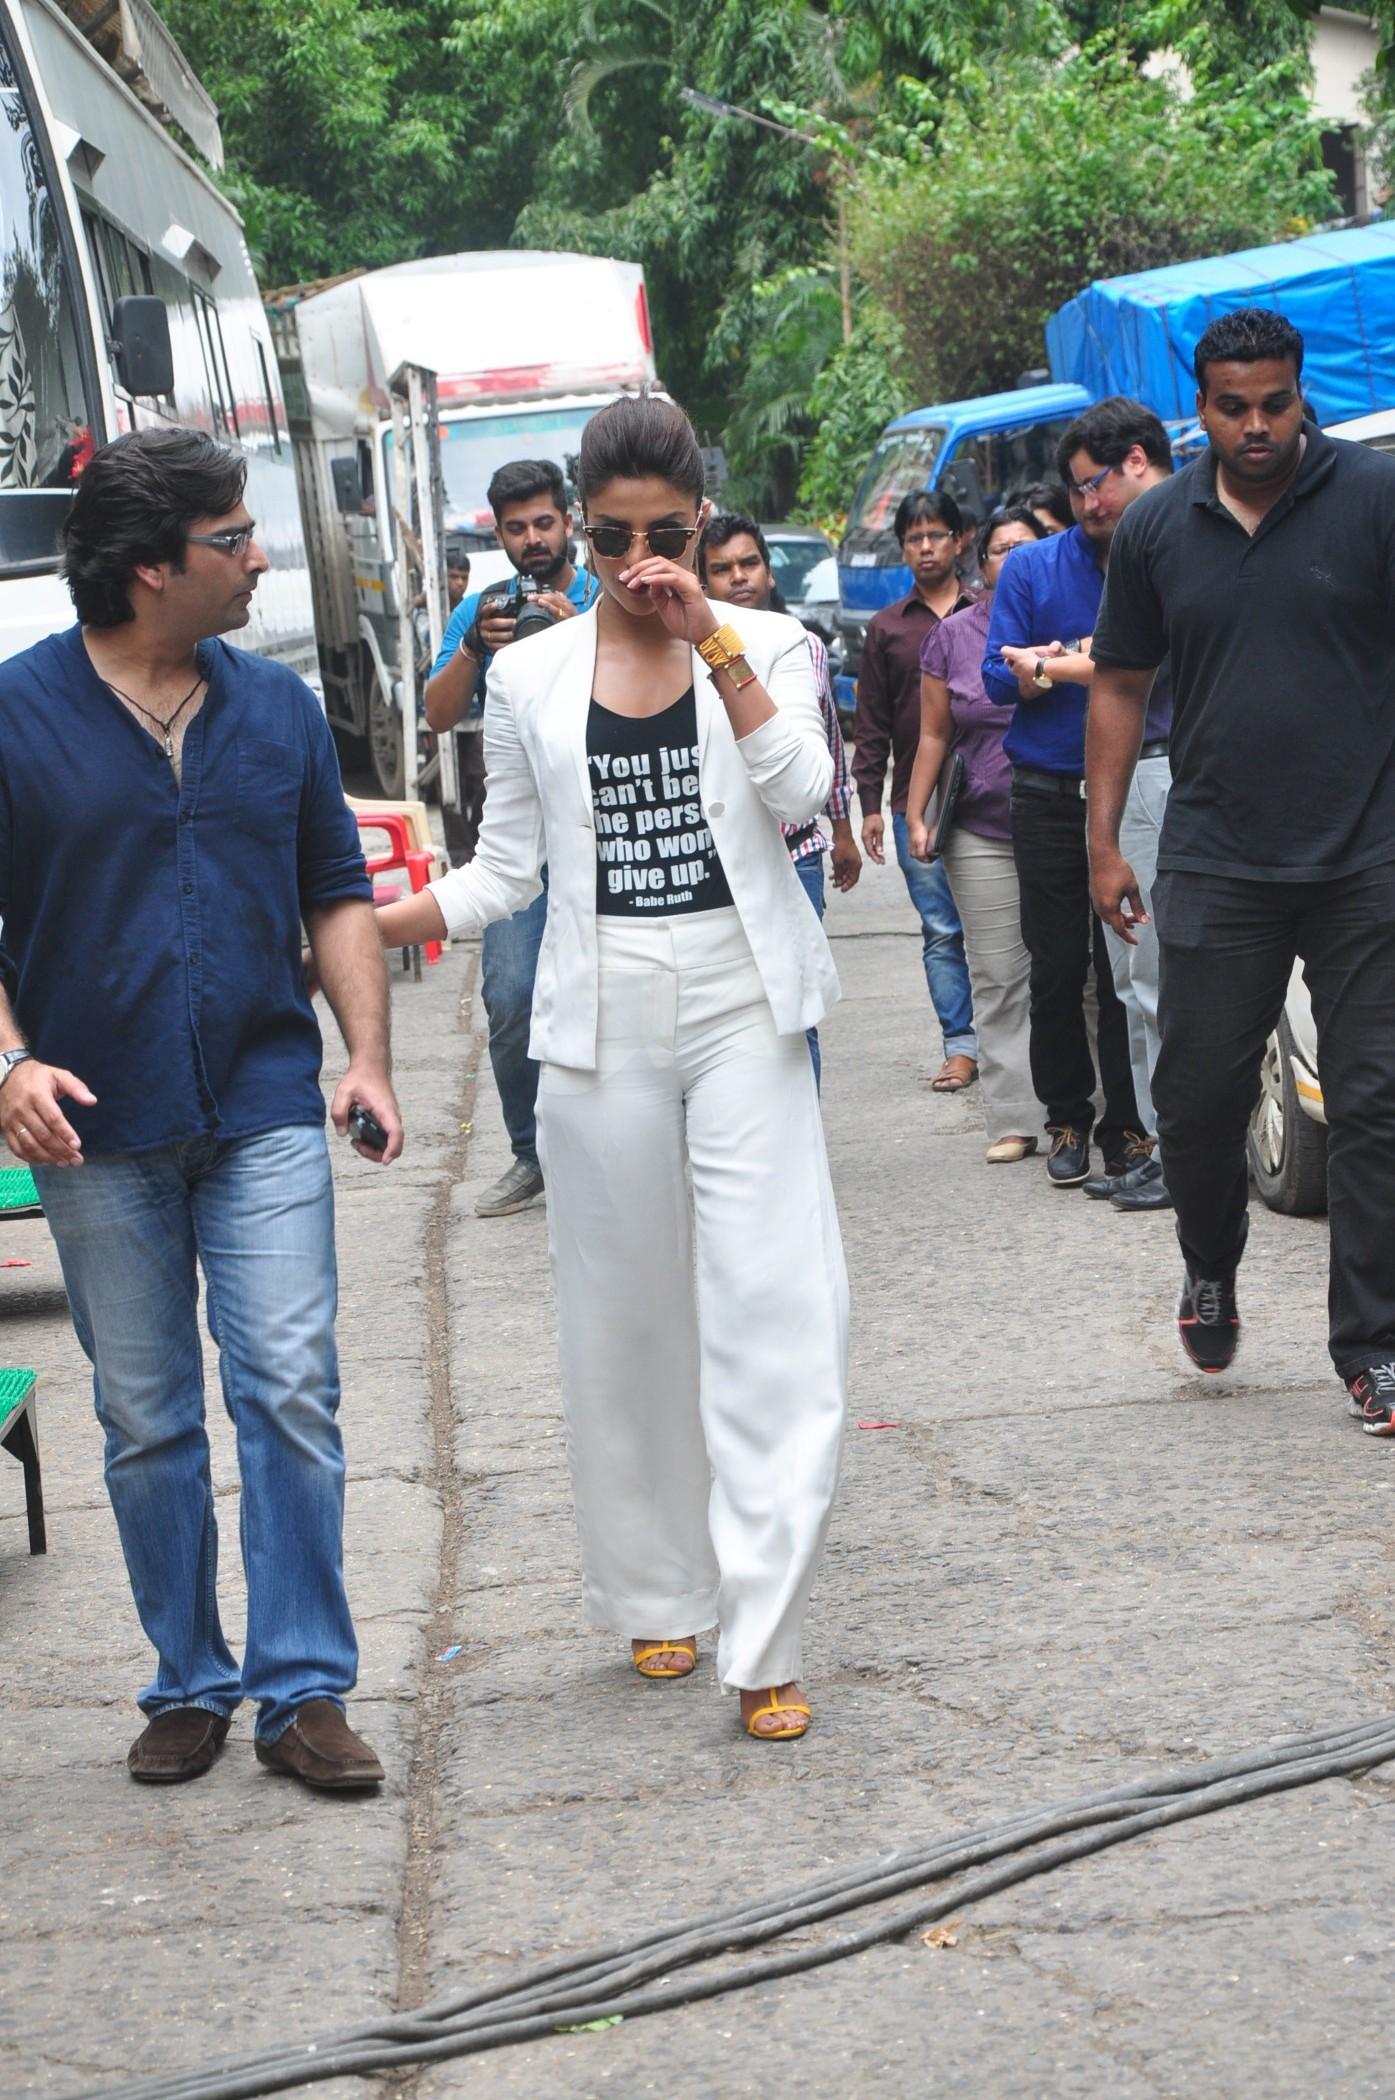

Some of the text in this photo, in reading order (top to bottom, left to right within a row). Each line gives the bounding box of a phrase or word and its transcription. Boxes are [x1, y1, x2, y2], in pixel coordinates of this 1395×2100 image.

[662, 774, 699, 800] be
[635, 802, 707, 835] pers
[597, 836, 651, 862] who
[607, 864, 666, 894] give
[635, 895, 665, 907] Babe
[666, 891, 693, 905] Ruth
